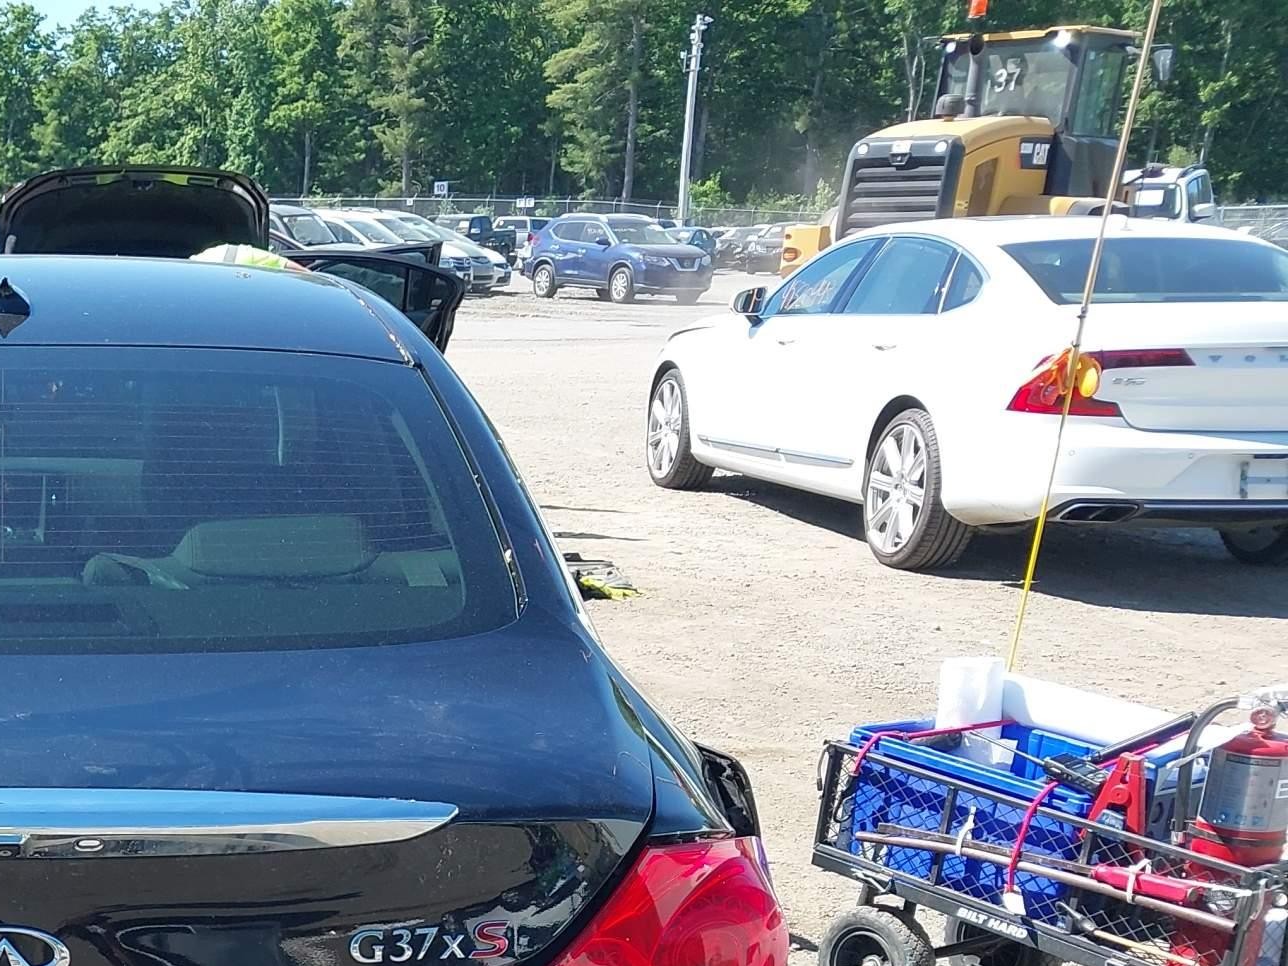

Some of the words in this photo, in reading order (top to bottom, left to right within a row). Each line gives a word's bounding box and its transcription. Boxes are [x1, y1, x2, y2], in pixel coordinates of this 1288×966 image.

[994, 68, 1021, 92] 37
[1033, 143, 1051, 165] CAT
[436, 184, 445, 192] 10
[957, 907, 988, 924] BILT
[987, 918, 1028, 939] HARD
